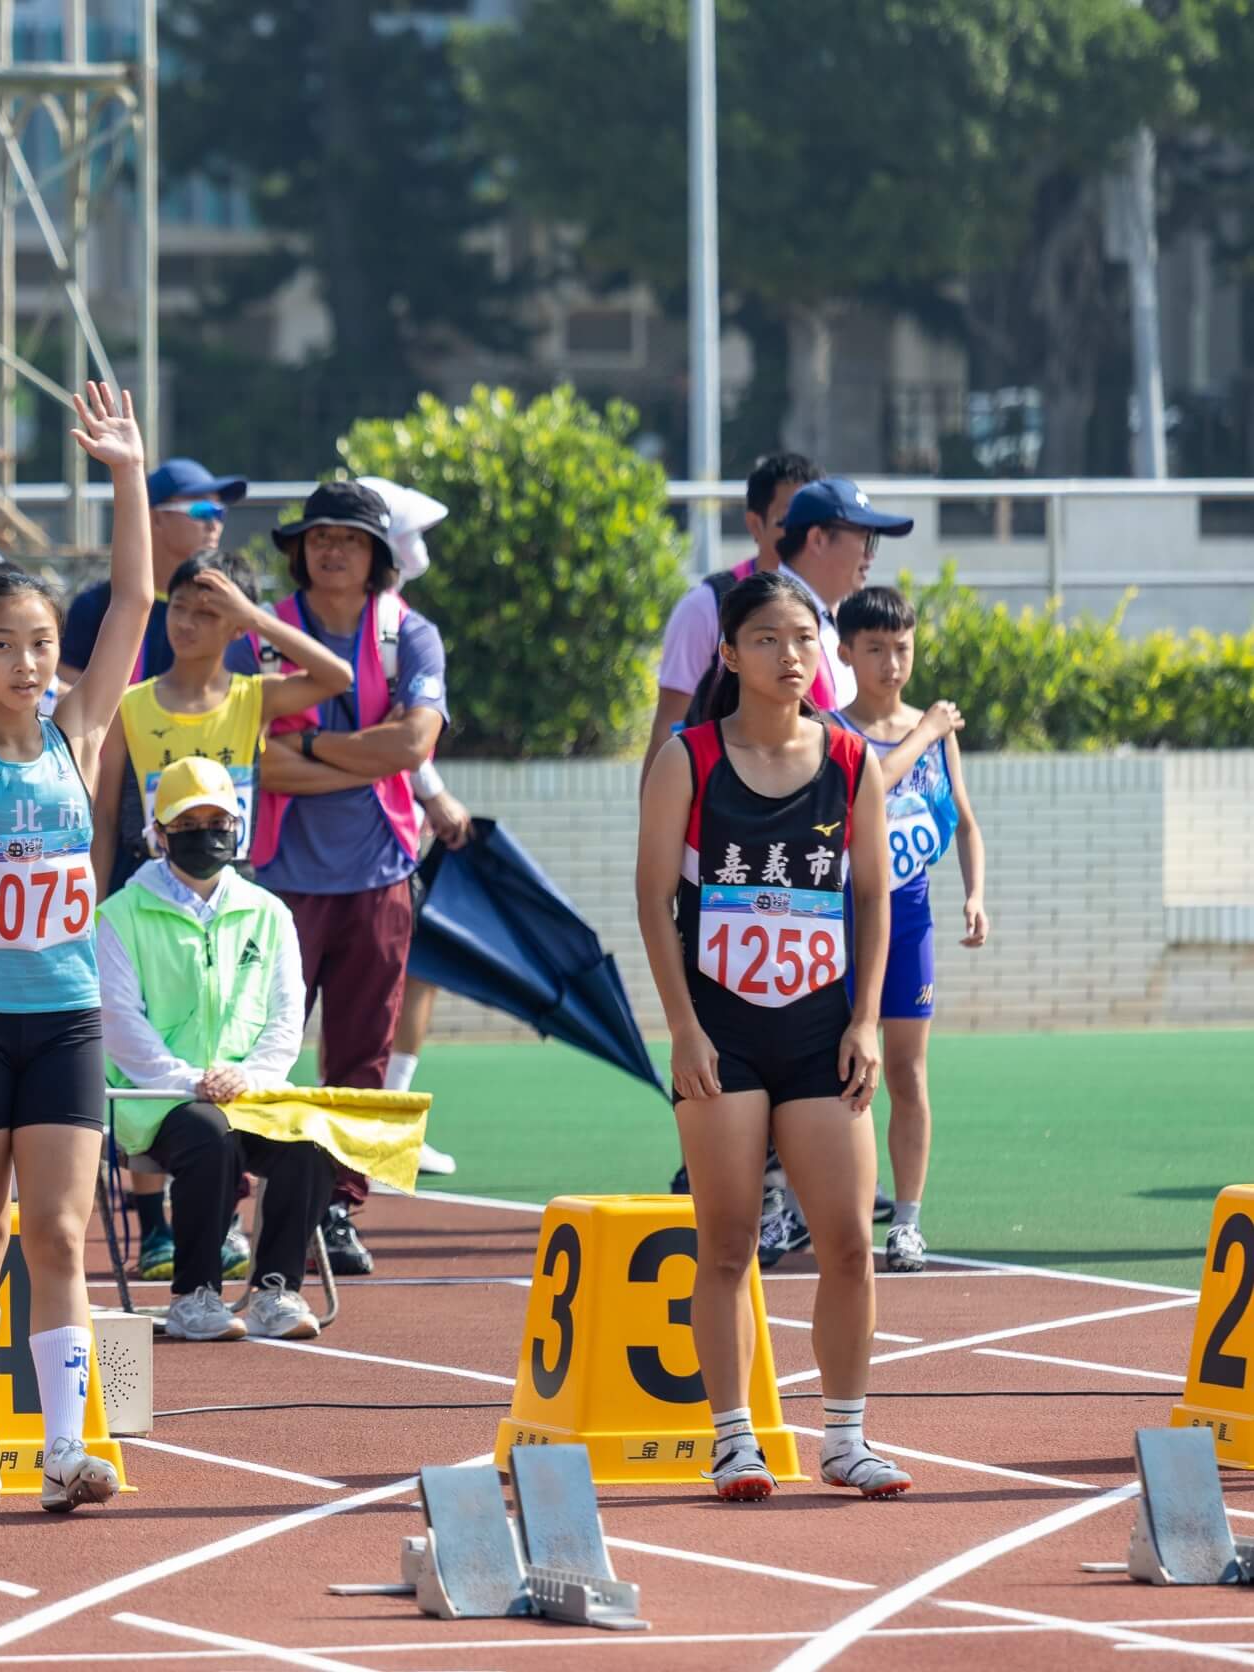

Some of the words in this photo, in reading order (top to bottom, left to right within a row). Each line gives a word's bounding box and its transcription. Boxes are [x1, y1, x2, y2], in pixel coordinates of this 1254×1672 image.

[714, 842, 835, 887] 嘉義市
[707, 923, 837, 996] 1258
[532, 1223, 581, 1399] 3
[626, 1227, 709, 1404] 3
[1199, 1212, 1254, 1389] 2
